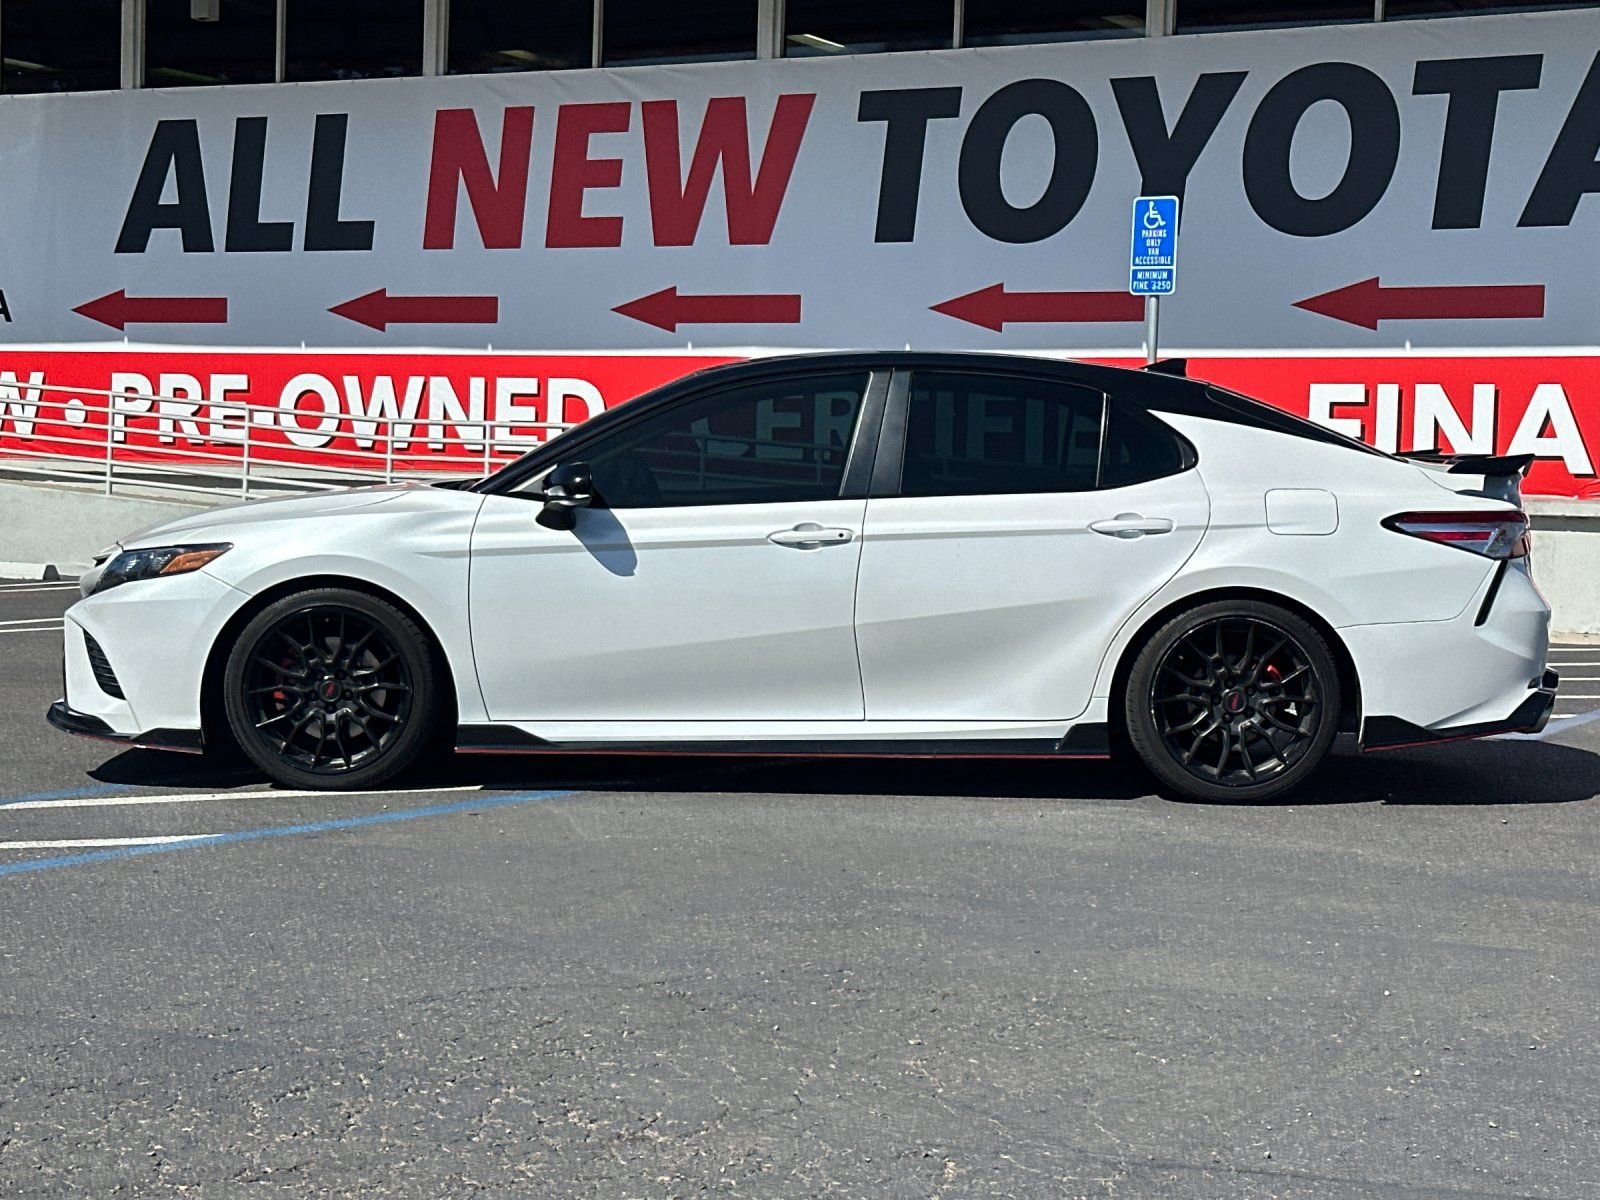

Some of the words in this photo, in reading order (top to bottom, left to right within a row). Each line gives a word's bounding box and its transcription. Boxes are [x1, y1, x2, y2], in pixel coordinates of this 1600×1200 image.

[114, 114, 374, 253] ALL
[426, 94, 815, 248] NEW
[857, 49, 1600, 244] TOYOTA
[1141, 229, 1167, 238] PARKING
[1145, 238, 1161, 247] ONLY
[1147, 247, 1159, 256] VAN
[1134, 255, 1171, 265] ACCESSIBLE
[1136, 271, 1168, 280] MINIMUM
[1132, 280, 1149, 290] FINE
